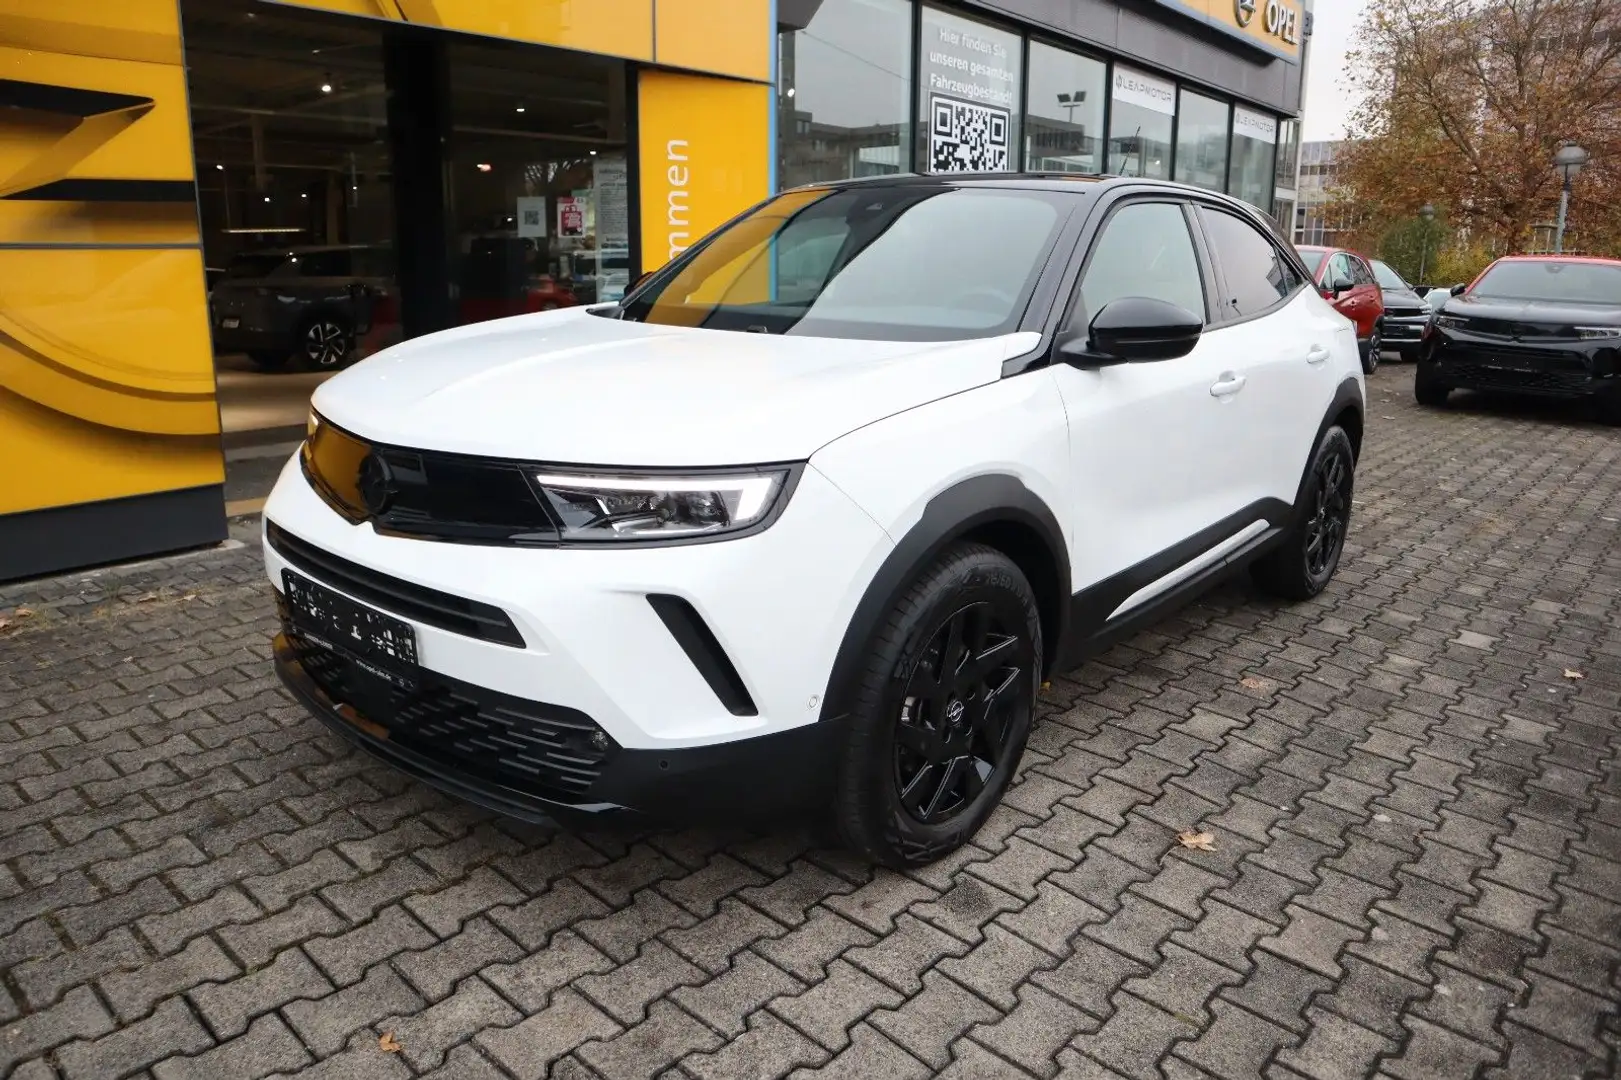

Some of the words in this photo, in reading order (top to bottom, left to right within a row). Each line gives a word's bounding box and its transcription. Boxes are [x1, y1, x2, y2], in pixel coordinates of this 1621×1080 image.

[1265, 0, 1300, 45] OPEL
[940, 27, 959, 45] Hier
[961, 33, 992, 55] finden
[992, 43, 1008, 58] Sie
[929, 51, 968, 71] unseren
[969, 61, 1014, 82] gesamten
[930, 72, 1012, 104] Fahrzeugbestand!
[1122, 78, 1172, 103] LEAPMOTOR
